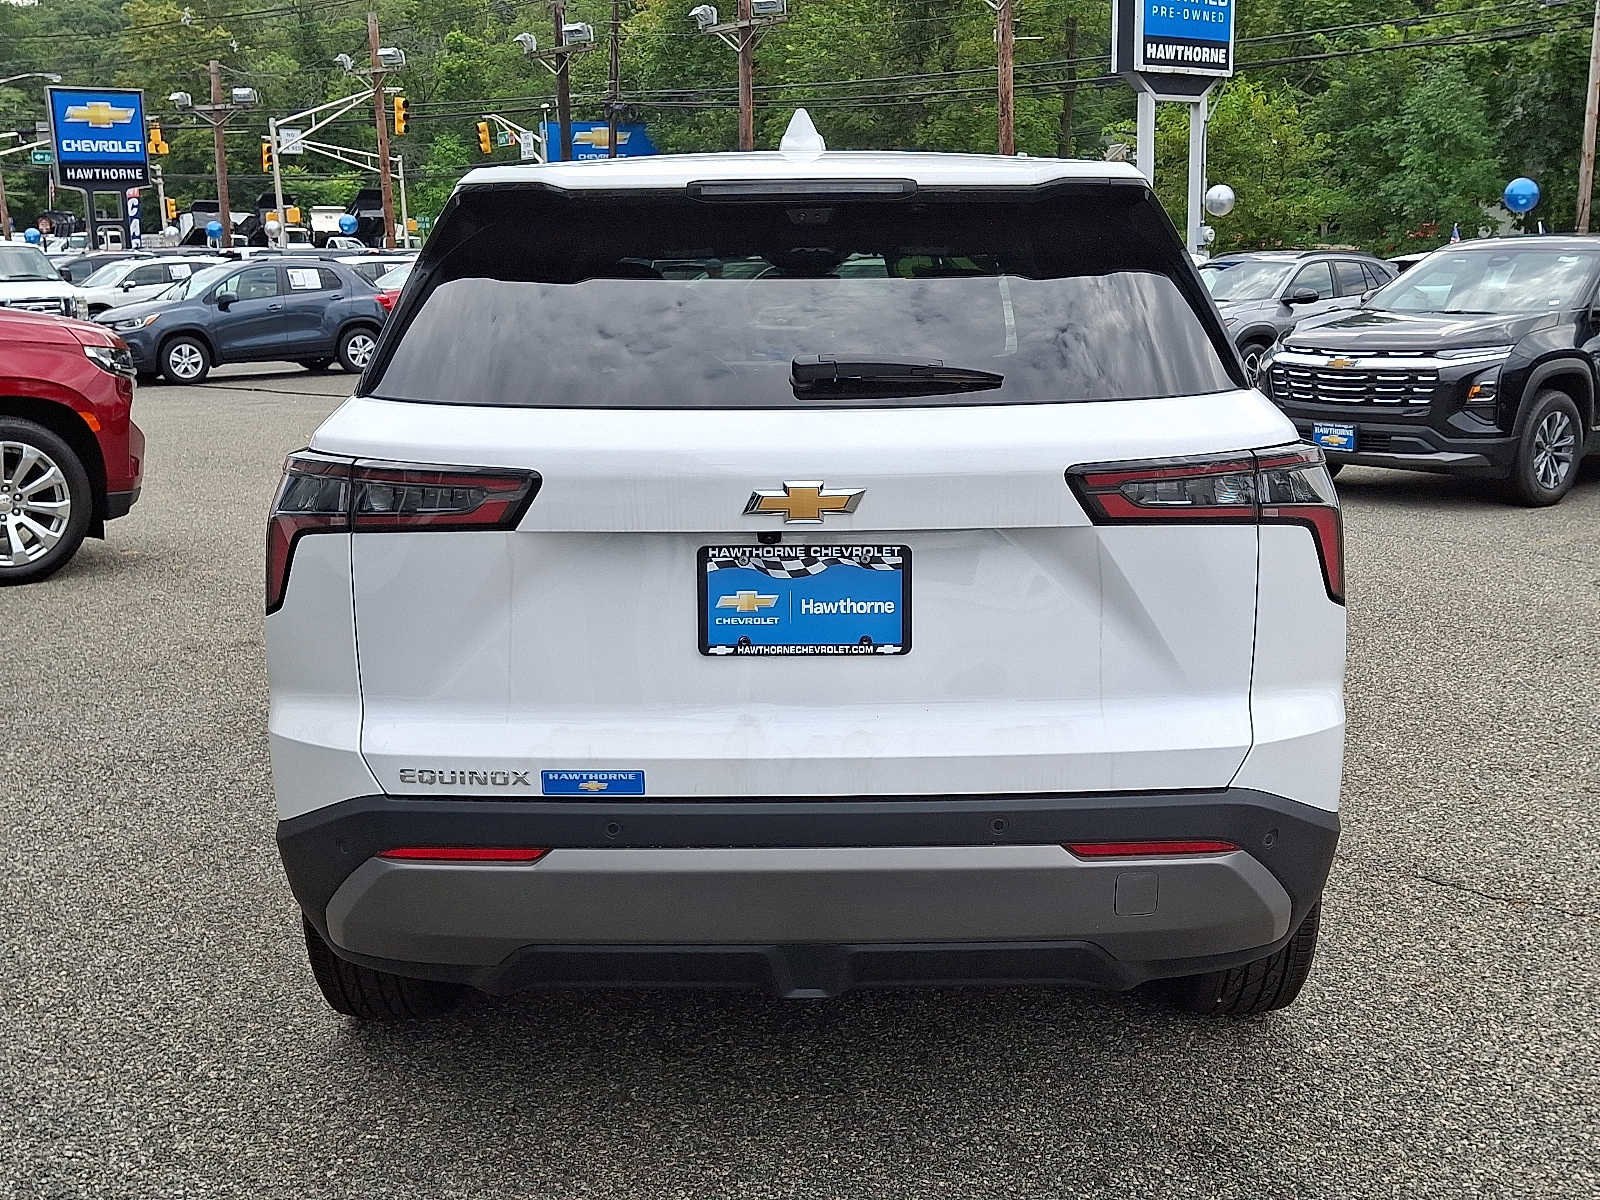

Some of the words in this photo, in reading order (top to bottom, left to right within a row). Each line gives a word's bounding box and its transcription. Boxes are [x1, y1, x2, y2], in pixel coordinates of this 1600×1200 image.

[1152, 5, 1225, 23] PRE-OWNED
[1146, 43, 1227, 64] HAWTHORNE
[61, 139, 142, 152] CHEVROLET
[66, 168, 144, 180] HAWTHORNE
[708, 547, 806, 558] HAWTHORNE
[810, 547, 901, 558] CHEVROLET
[800, 597, 895, 615] Hawthorne
[715, 617, 780, 625] CHEVROLET
[737, 645, 874, 655] HAWTHORNECHEVROLET.COM
[399, 768, 532, 786] EQUINOX
[548, 773, 637, 781] HAWTHORNE
